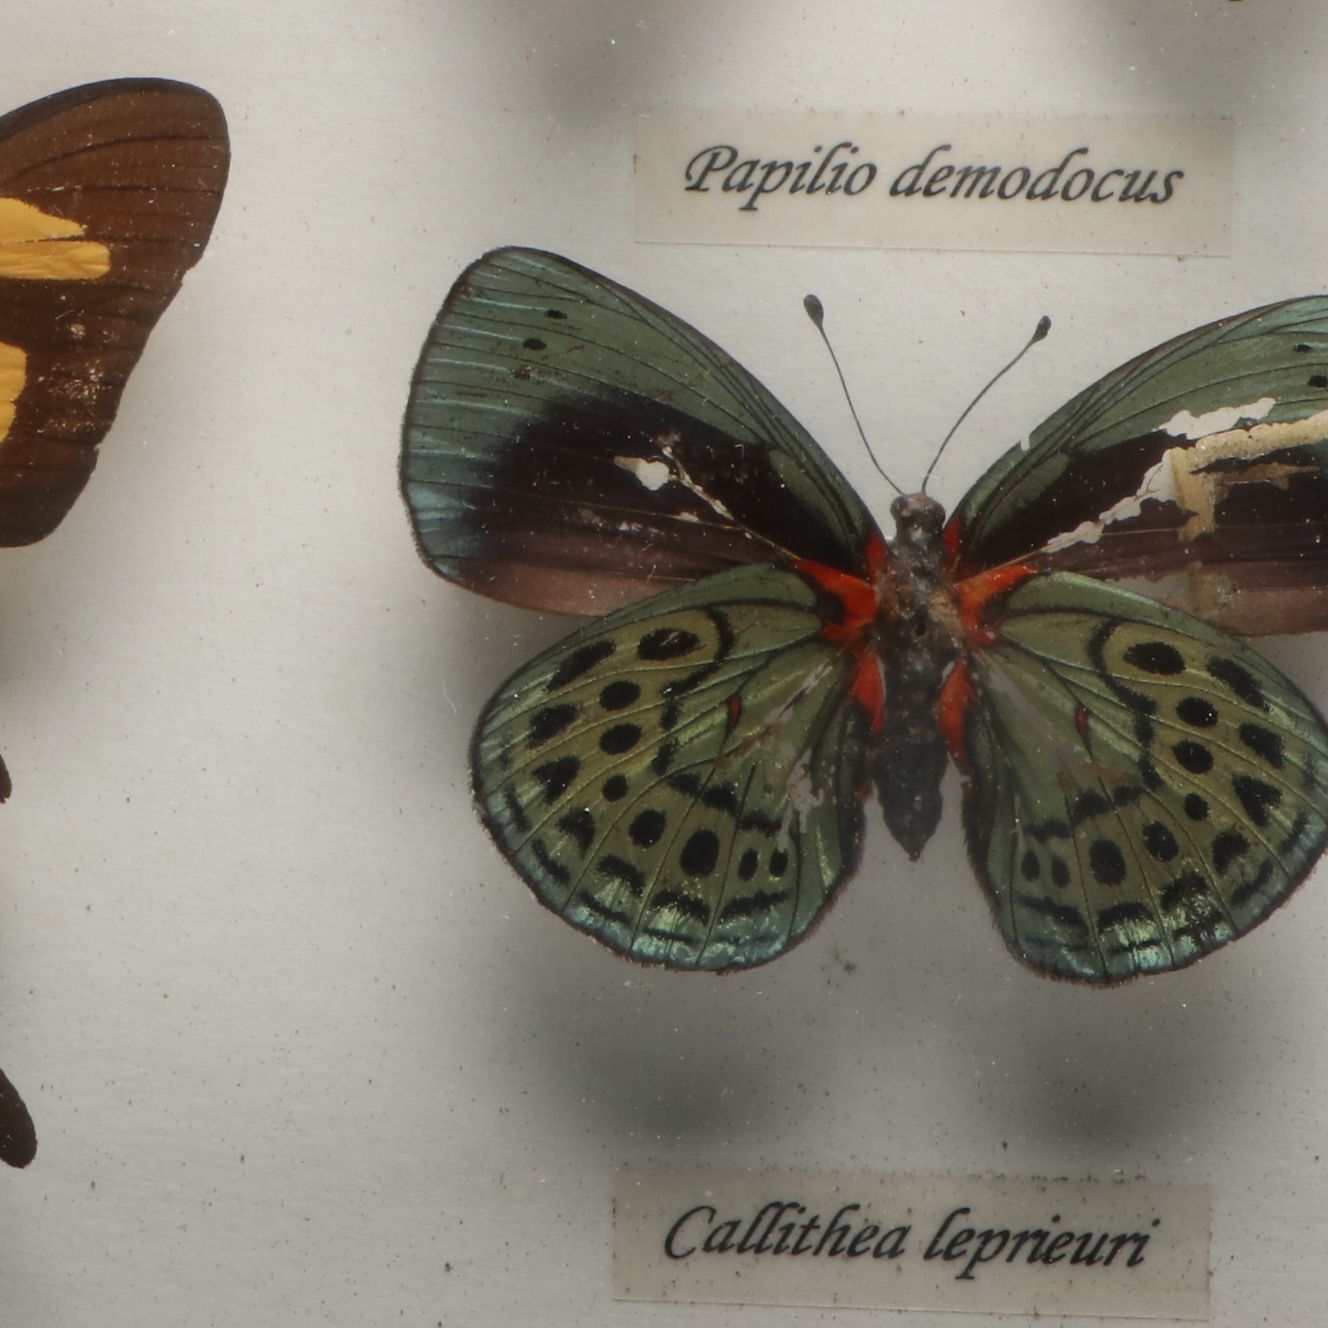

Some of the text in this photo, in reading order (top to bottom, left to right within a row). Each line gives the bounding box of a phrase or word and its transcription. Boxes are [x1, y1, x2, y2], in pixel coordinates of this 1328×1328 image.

[684, 141, 1185, 212] Papilio demodocus
[664, 1201, 1161, 1281] Callithea leprieuri
